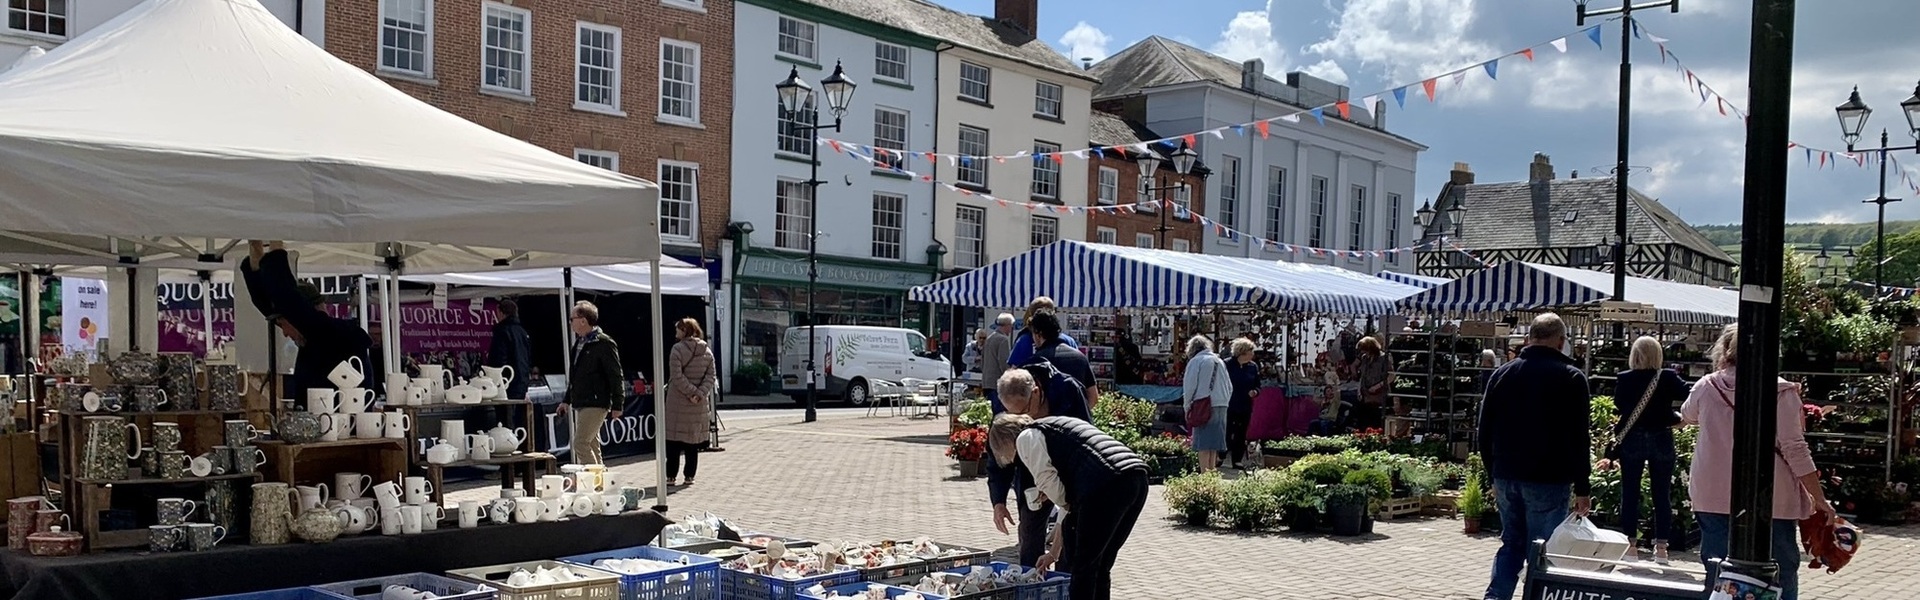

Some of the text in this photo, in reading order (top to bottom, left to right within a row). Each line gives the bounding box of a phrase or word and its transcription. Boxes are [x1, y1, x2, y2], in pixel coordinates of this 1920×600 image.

[753, 260, 777, 273] THE
[781, 262, 823, 277] CASTE
[827, 268, 890, 283] BOOKSHOP
[78, 286, 100, 295] on sale
